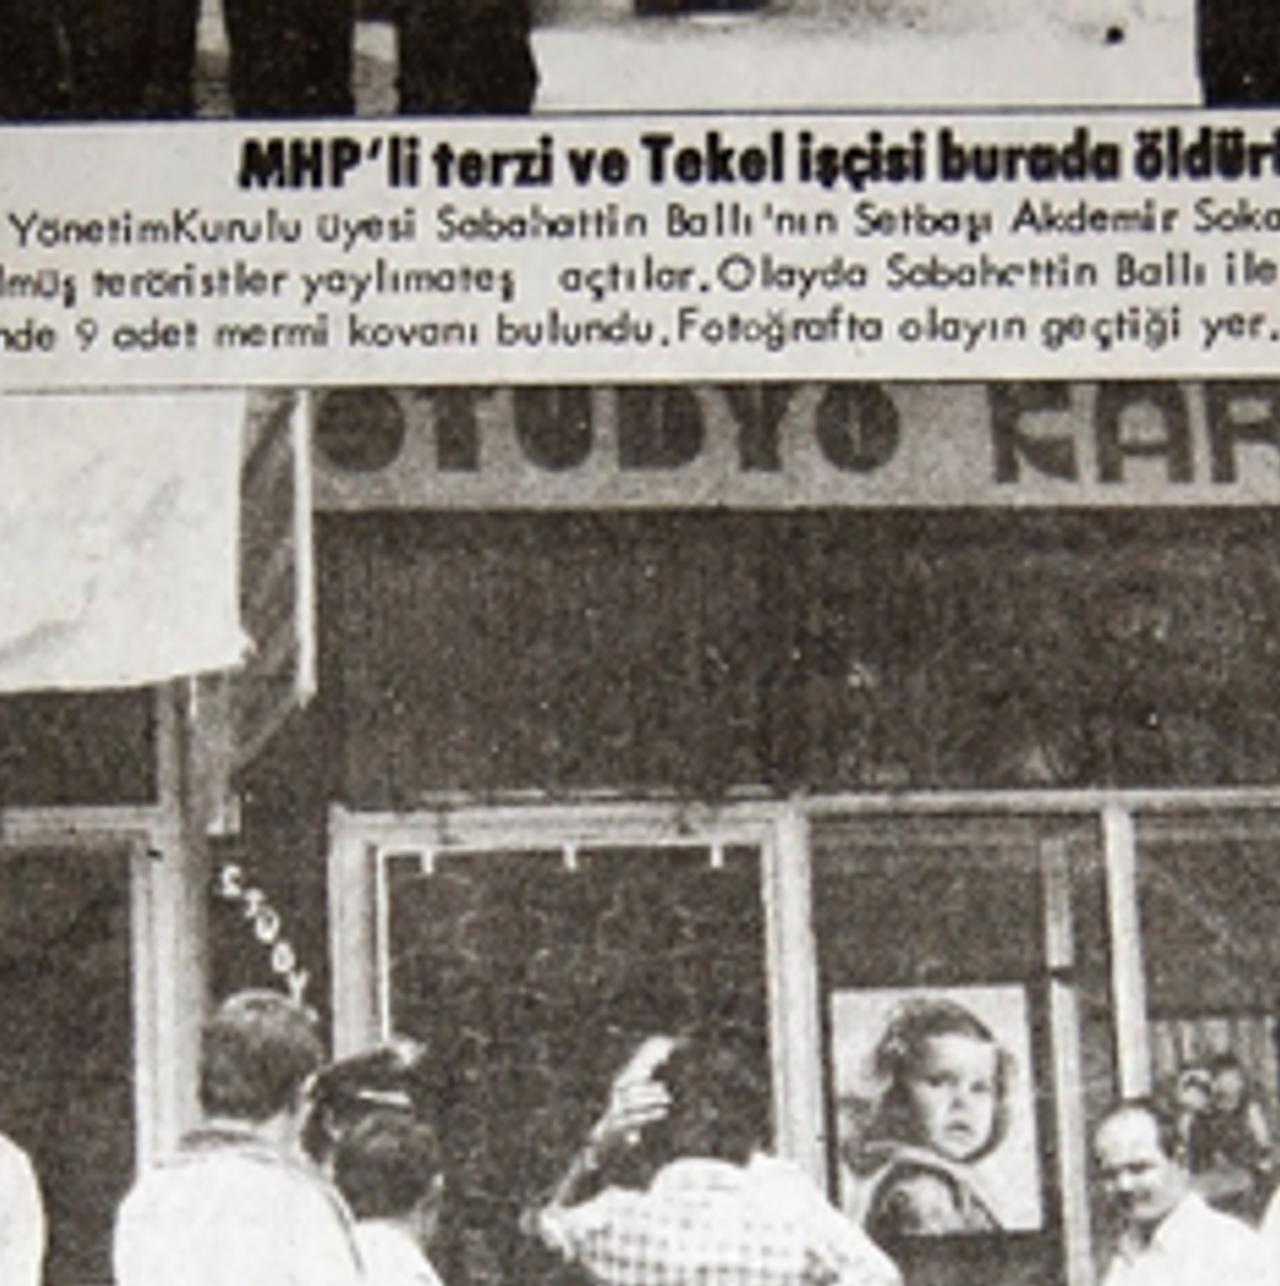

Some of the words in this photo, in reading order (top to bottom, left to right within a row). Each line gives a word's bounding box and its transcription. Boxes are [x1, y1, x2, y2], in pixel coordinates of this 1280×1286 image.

[237, 133, 420, 190] MHP'li
[431, 133, 554, 188] terzi
[567, 147, 630, 187] ve
[639, 129, 785, 185] Tekel
[798, 129, 926, 193] işçisi
[937, 125, 1122, 183] burada
[316, 206, 416, 254] üyesi
[436, 202, 648, 243] Sabahattin
[854, 199, 993, 245] Setbaşı
[1010, 197, 1180, 234] Akdemir
[91, 260, 289, 298] teröristler
[1116, 249, 1206, 288] Ballı
[1225, 249, 1278, 286] ile
[74, 316, 99, 353] 9
[111, 316, 198, 351] adet
[214, 312, 329, 348] mermi
[348, 312, 479, 348] kovanı
[897, 305, 1027, 353] olayın
[1041, 303, 1181, 352] geçtiği
[1201, 312, 1280, 350] yer.
